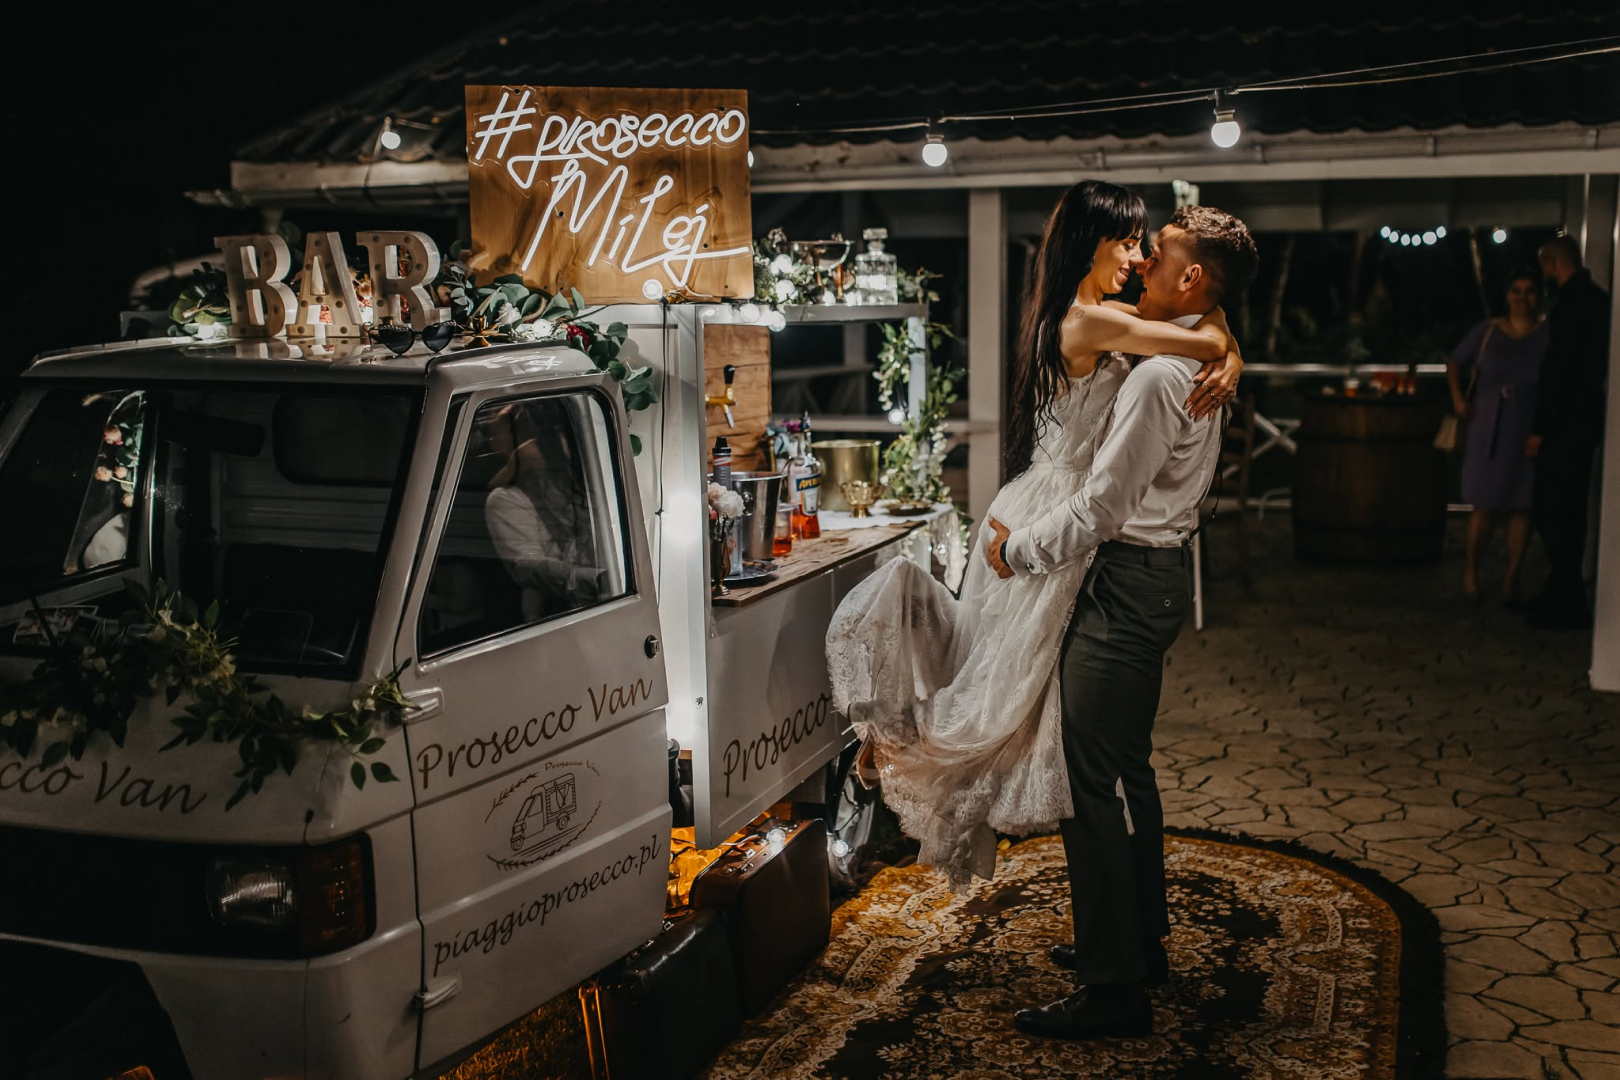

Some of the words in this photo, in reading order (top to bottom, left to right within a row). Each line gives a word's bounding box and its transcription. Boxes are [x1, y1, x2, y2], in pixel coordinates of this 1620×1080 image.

[213, 230, 451, 338] BAR
[94, 761, 208, 814] Van
[416, 704, 582, 790] Prosecco
[587, 678, 653, 722] Van
[723, 692, 832, 798] Prosecco
[433, 834, 662, 977] piaggioprosecco.pl
